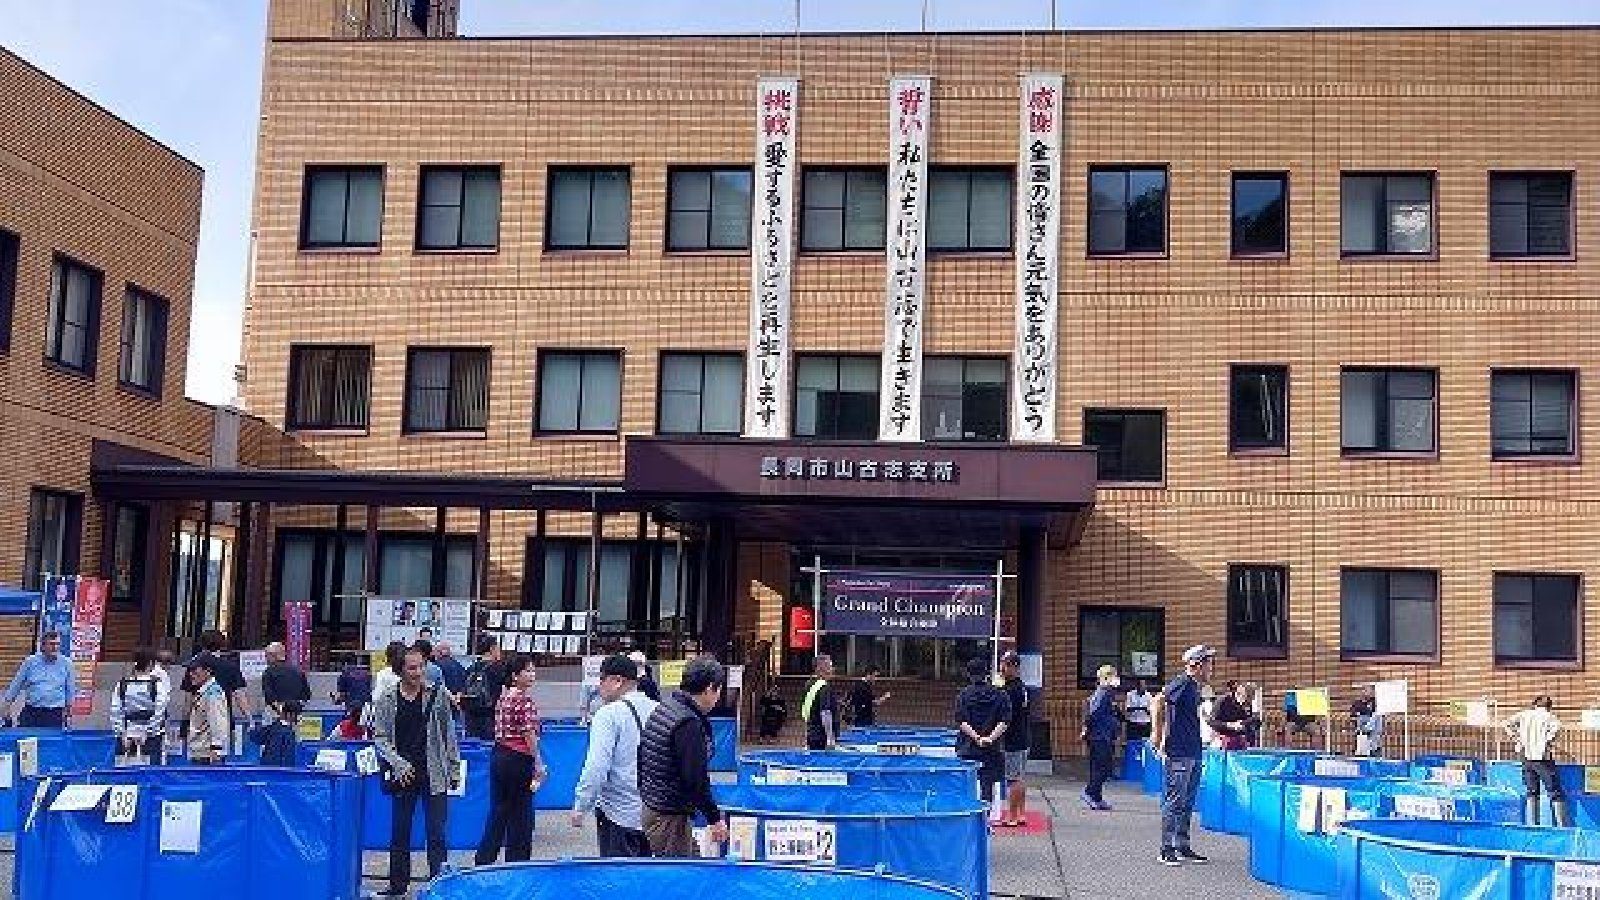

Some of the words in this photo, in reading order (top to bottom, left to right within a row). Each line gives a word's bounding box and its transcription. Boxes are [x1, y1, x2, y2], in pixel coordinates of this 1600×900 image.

[763, 90, 791, 136] 挑戦
[897, 87, 925, 135] 誓い
[1027, 87, 1056, 132] 感謝
[834, 595, 888, 612] Grand
[894, 596, 985, 620] Champion
[111, 791, 135, 818] 38
